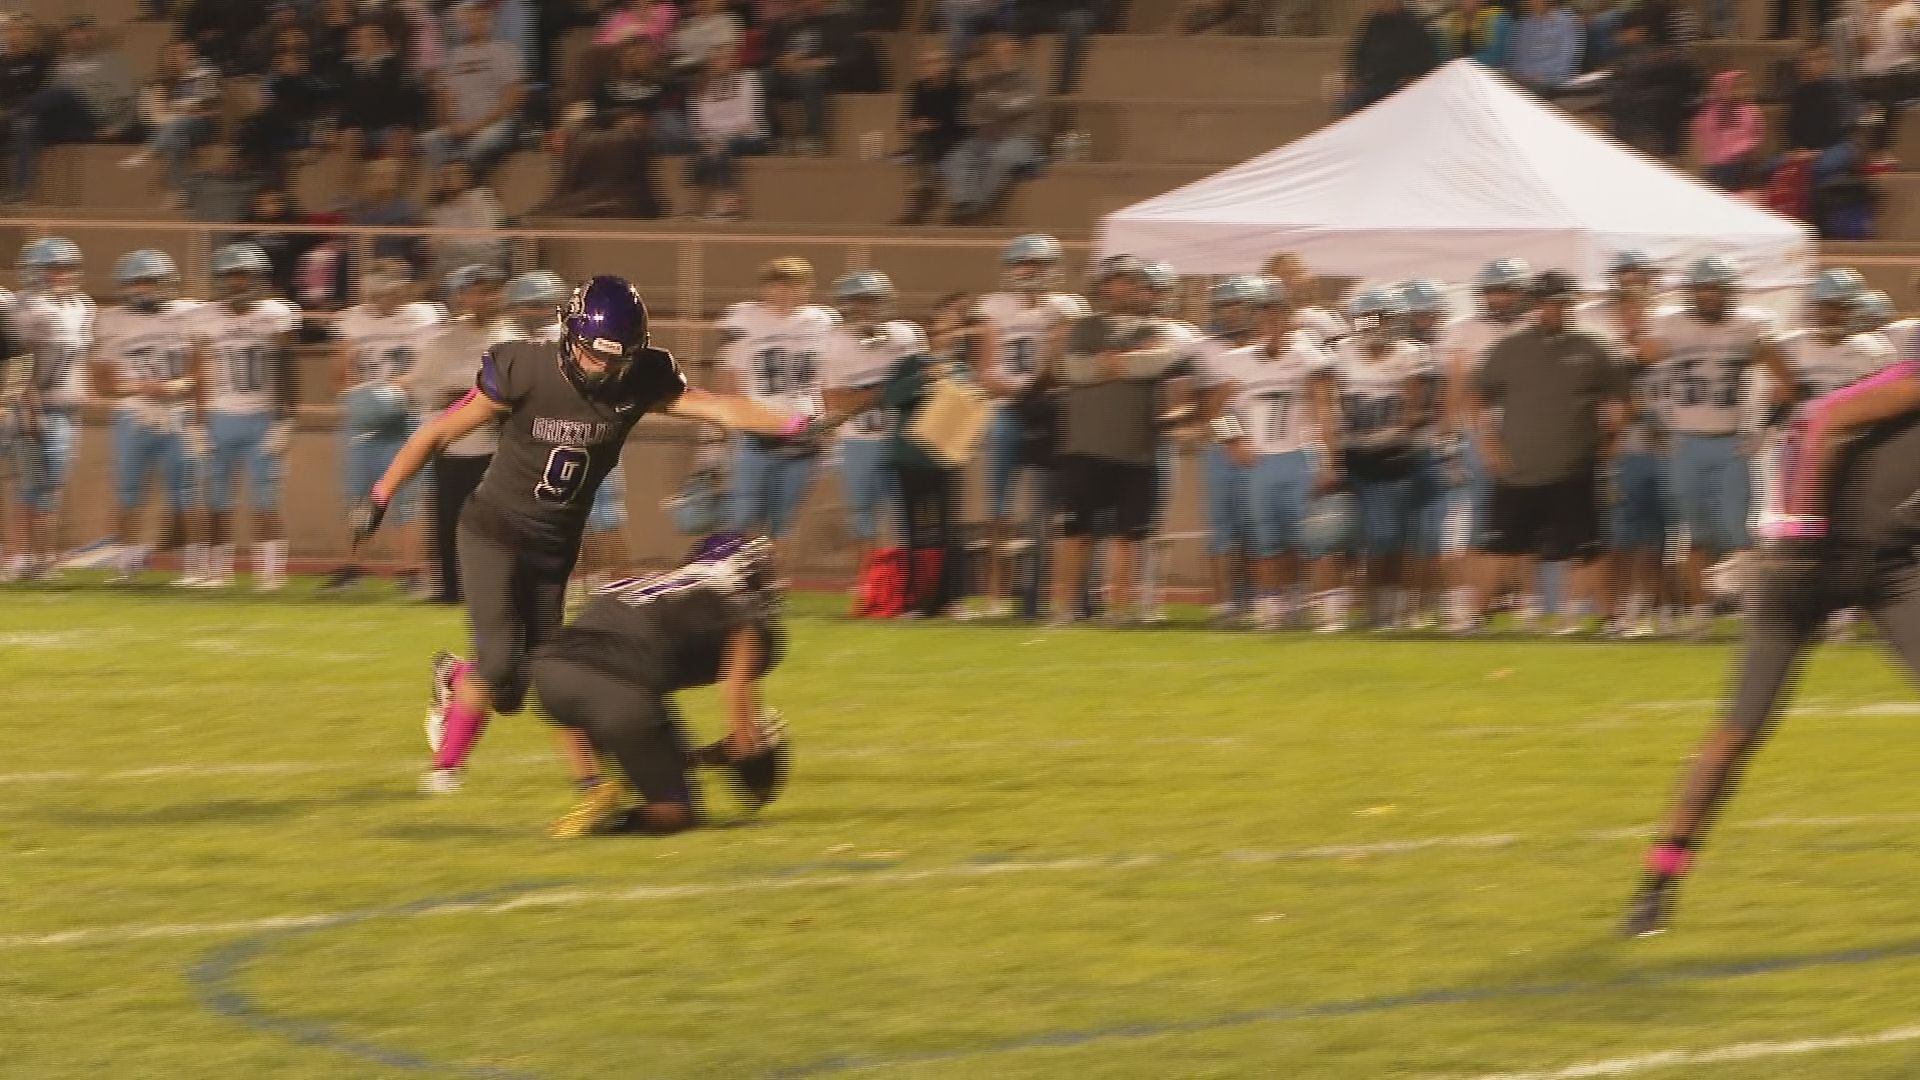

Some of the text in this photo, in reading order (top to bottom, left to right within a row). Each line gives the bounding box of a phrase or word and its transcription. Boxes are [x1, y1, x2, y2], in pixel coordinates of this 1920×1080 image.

[531, 416, 610, 446] GRIZZLI
[1254, 390, 1293, 440] 7
[533, 446, 591, 506] 9
